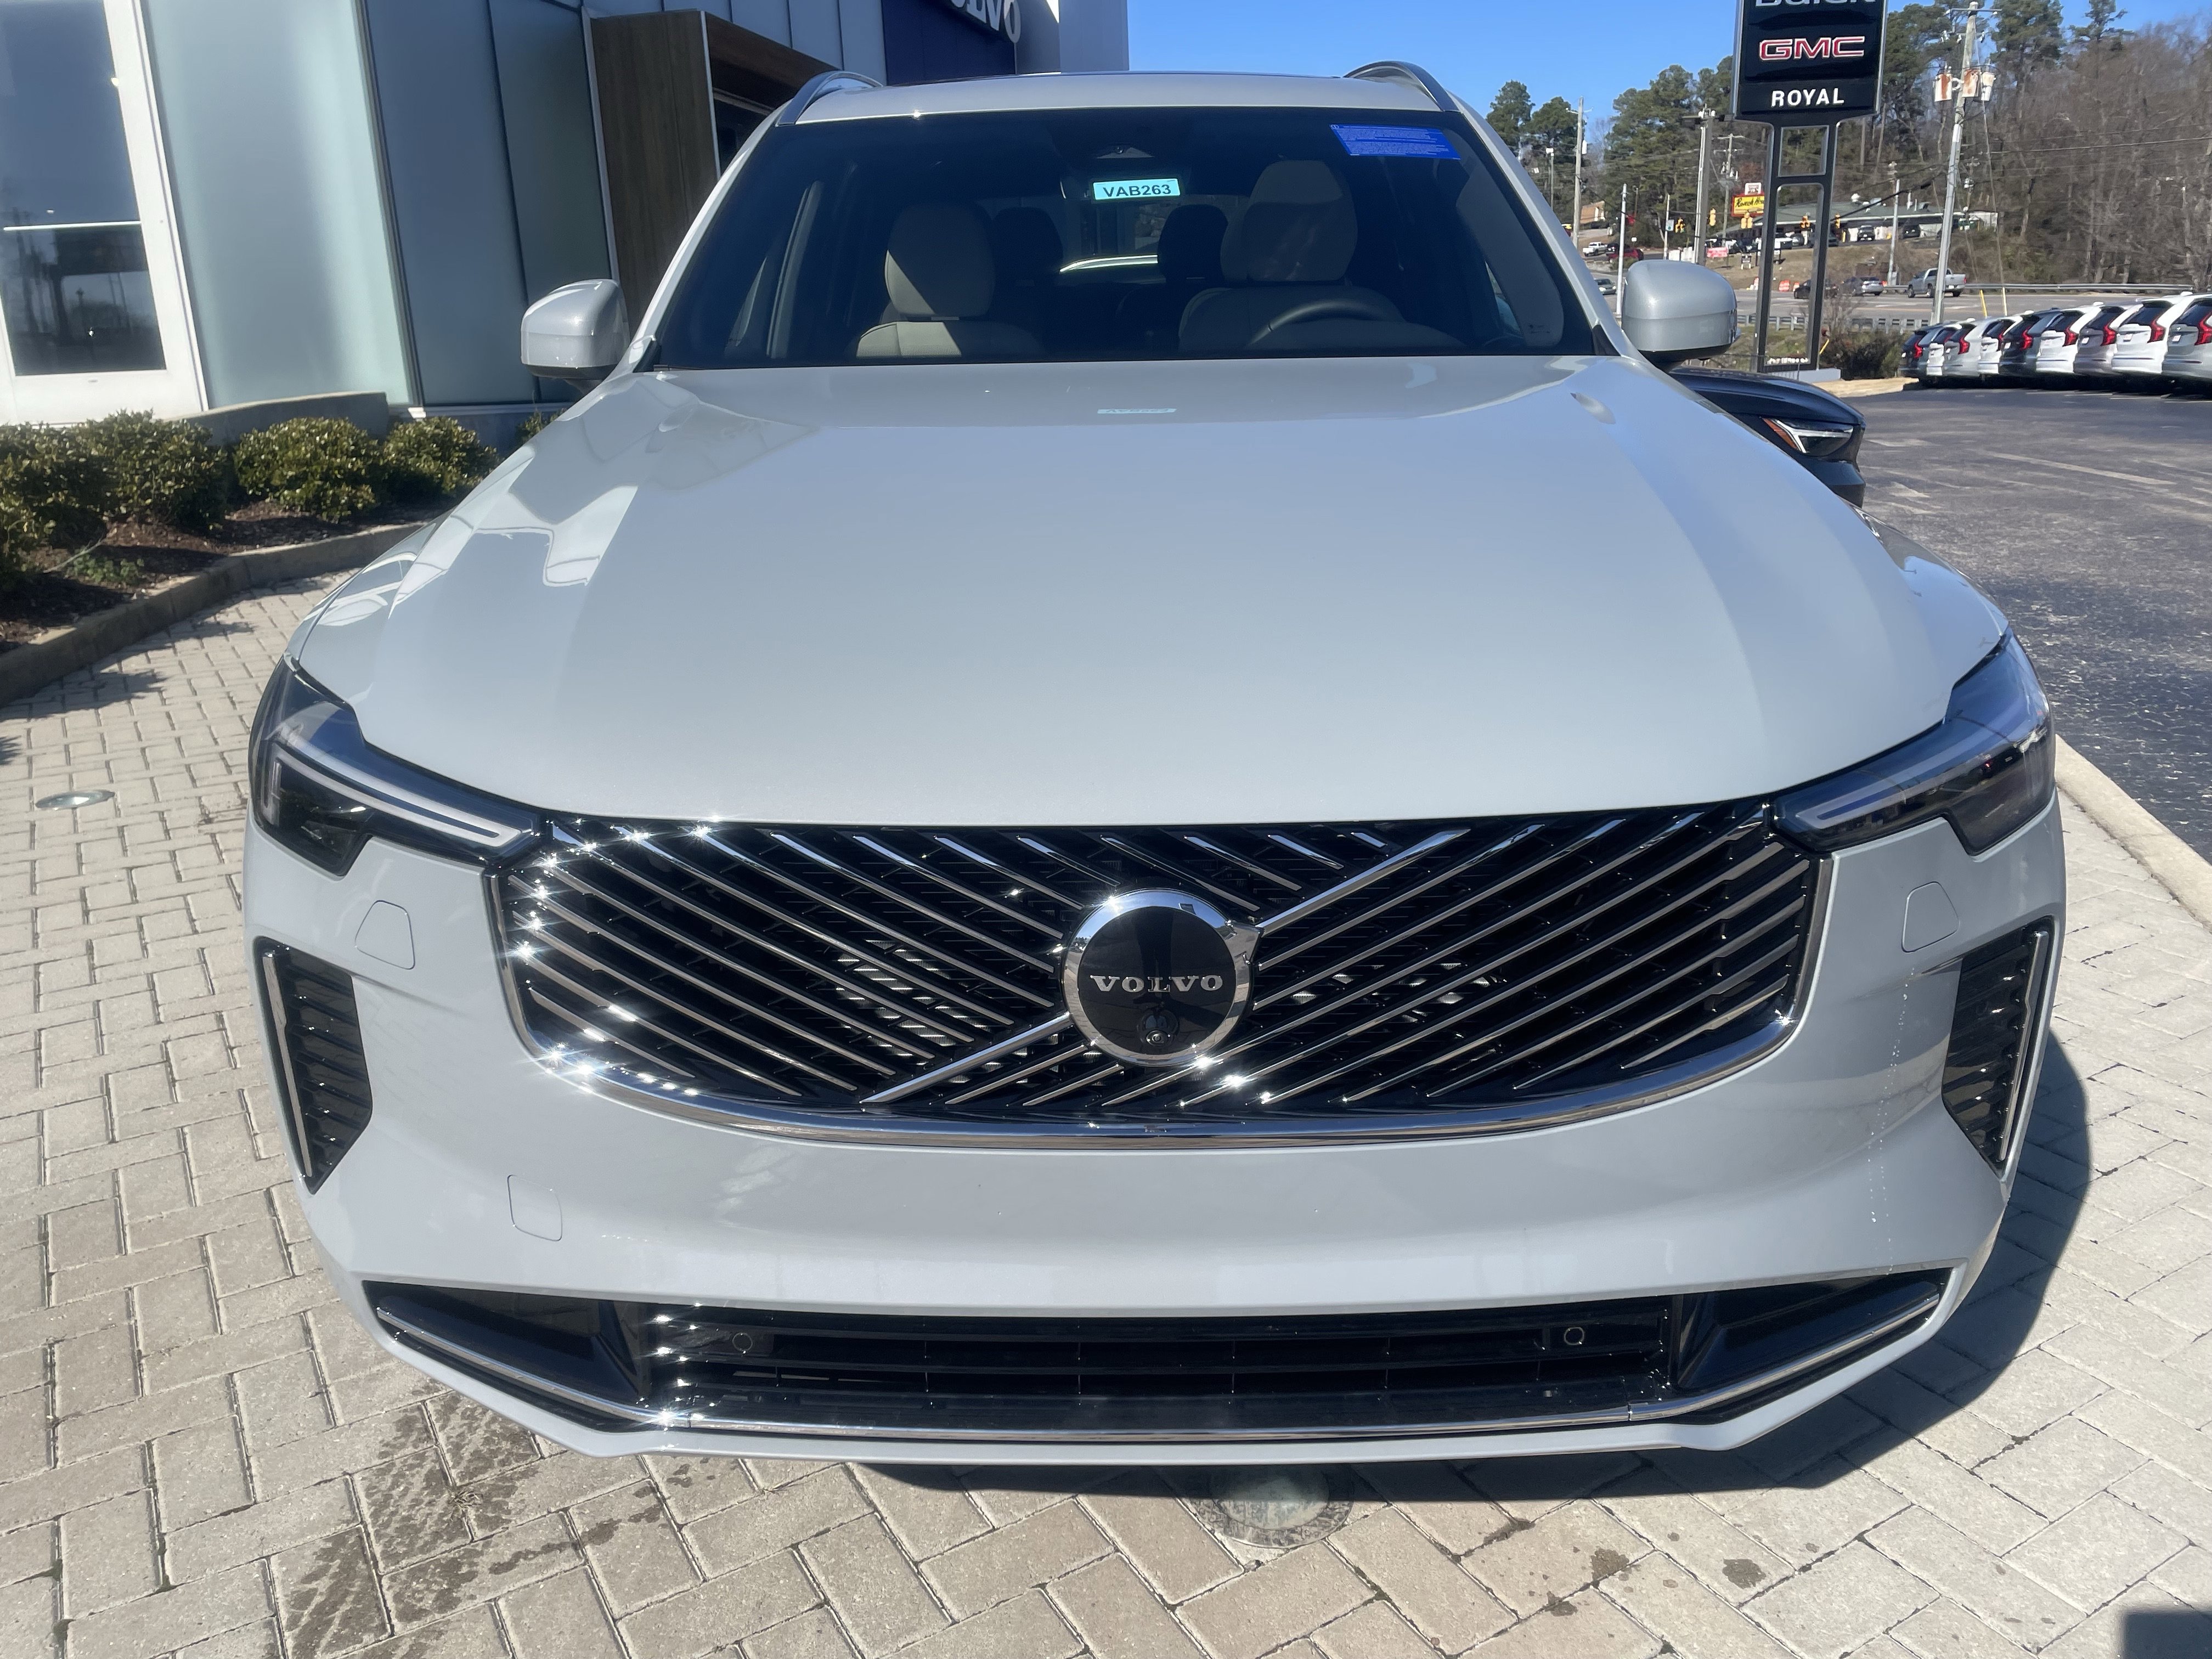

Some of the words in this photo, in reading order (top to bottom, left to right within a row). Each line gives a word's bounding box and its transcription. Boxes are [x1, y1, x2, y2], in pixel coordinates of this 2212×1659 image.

[1759, 36, 1865, 60] GMC
[1771, 88, 1844, 108] ROYAL
[1103, 184, 1171, 197] VAB263
[1090, 974, 1223, 992] VOLVO
